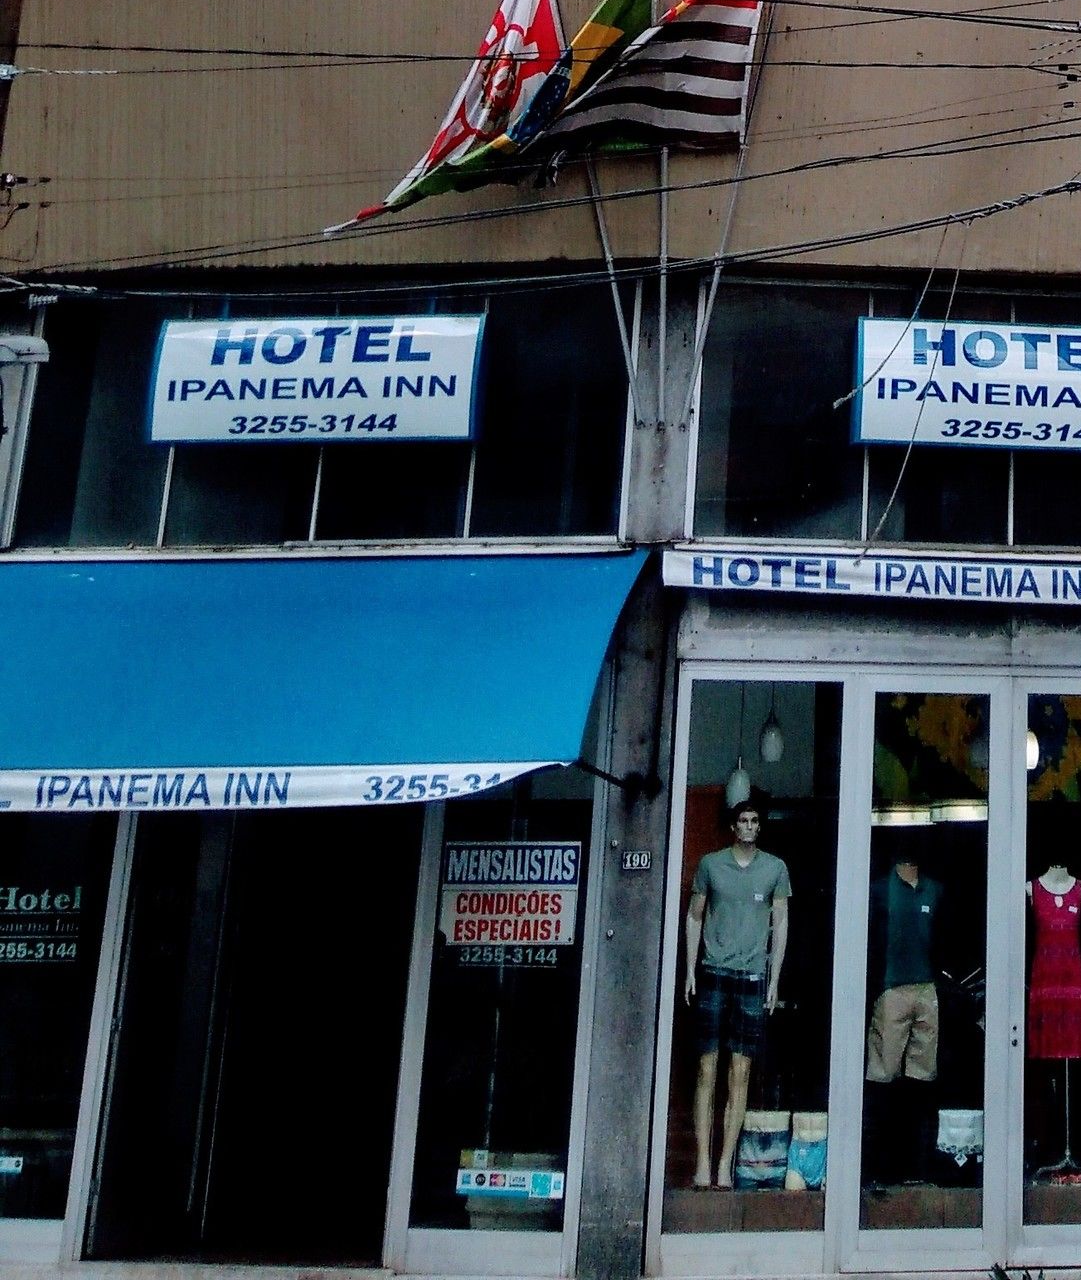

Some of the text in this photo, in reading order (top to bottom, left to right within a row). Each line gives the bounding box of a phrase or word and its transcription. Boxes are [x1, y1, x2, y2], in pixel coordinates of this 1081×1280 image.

[211, 325, 432, 366] HOTEL
[167, 375, 457, 402] IPANEMA INN
[228, 413, 398, 434] 3255-3144
[692, 556, 851, 591] HOTEL
[874, 561, 1040, 599] IPANEMA
[35, 772, 211, 808] IPANEMA
[223, 772, 291, 807] INN
[448, 848, 576, 881] MENSALISTAS
[626, 853, 648, 867] 190
[456, 889, 562, 917] CONDIÇÕES
[453, 919, 561, 941] ESPECIAIS!
[460, 946, 558, 964] 3255-3144
